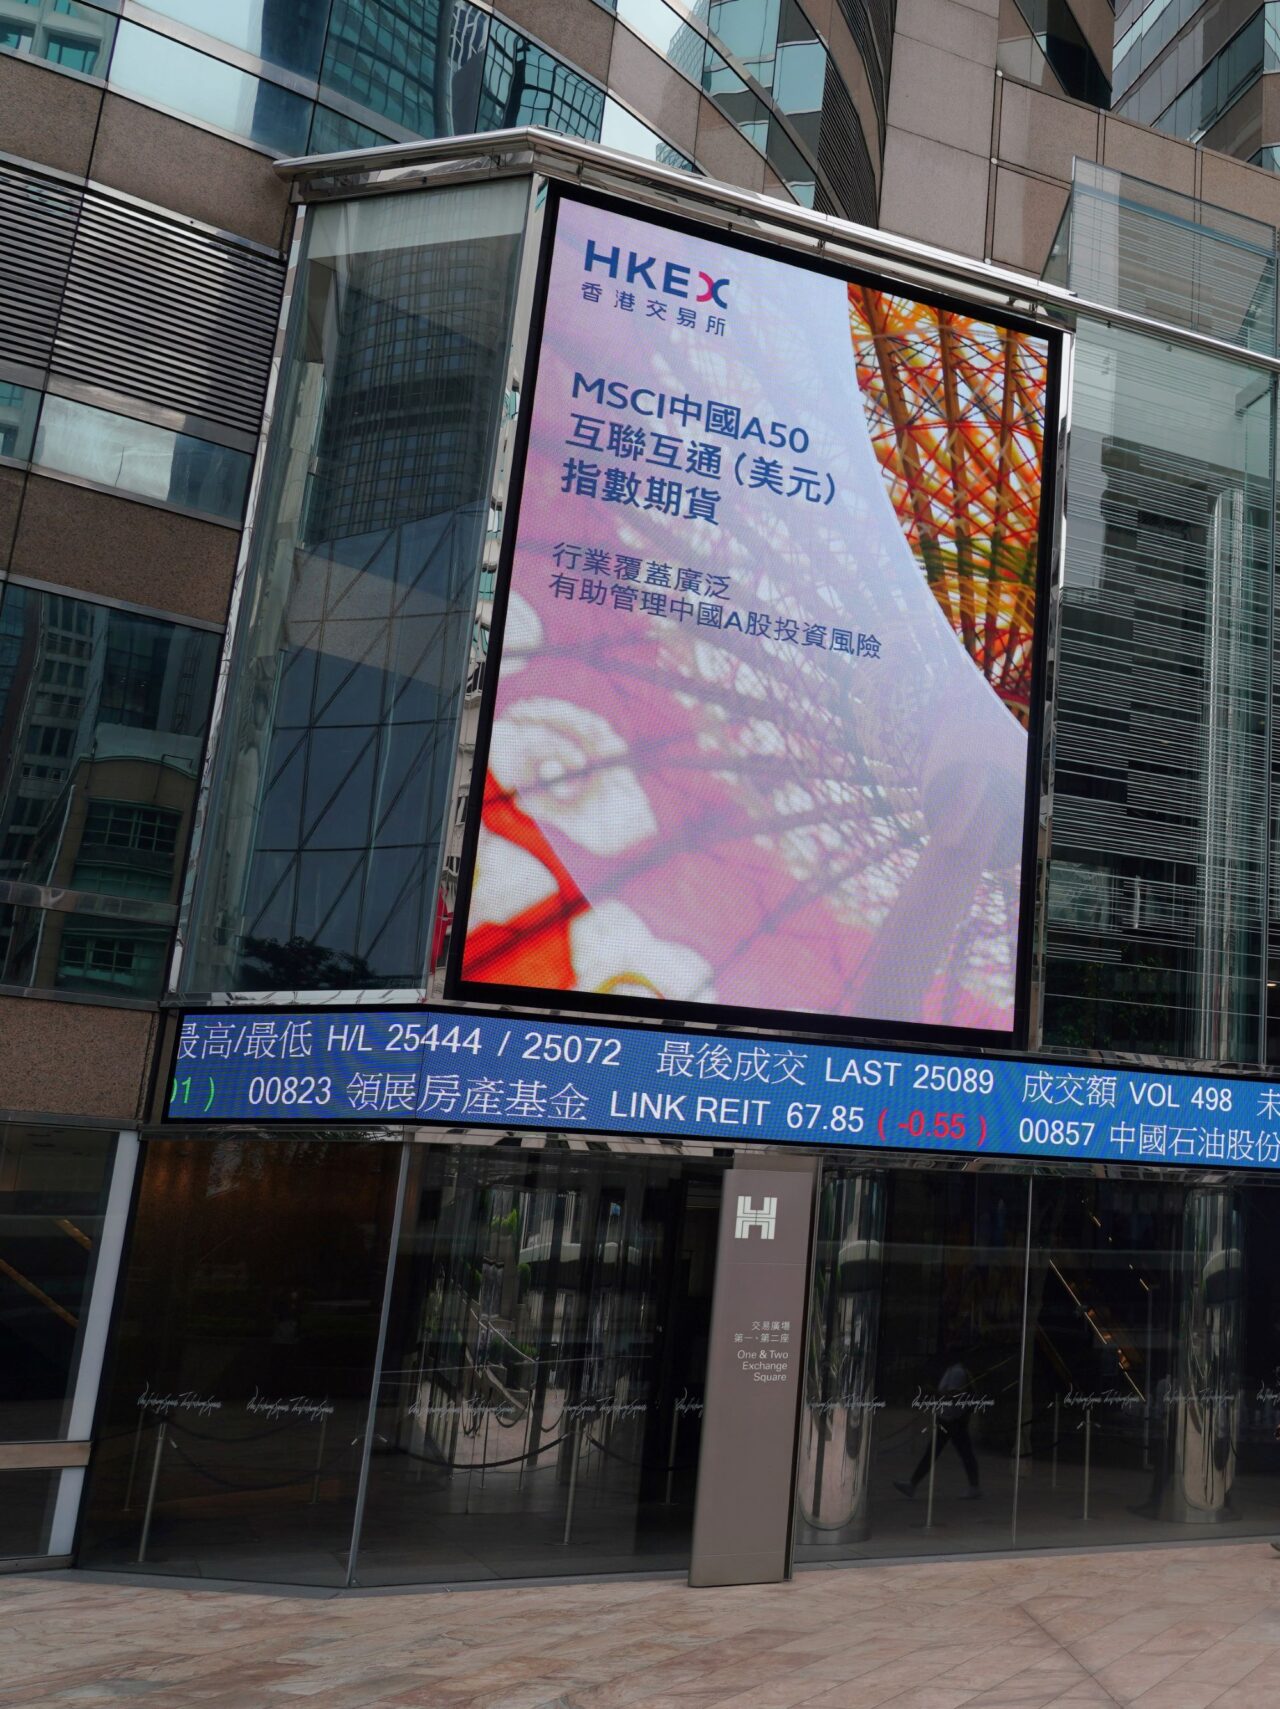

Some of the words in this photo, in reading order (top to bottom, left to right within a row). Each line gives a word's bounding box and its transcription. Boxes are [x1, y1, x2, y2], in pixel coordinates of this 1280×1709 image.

[584, 239, 731, 309] HKEX
[581, 281, 727, 337] 香港交易所
[571, 371, 810, 454] MSCI中國A50
[561, 457, 722, 526] 指數期貨
[552, 542, 732, 600] 行業覆蓋廣泛
[548, 573, 883, 659] 有助管理中國A股投資風險
[328, 1024, 373, 1052] H/L
[385, 1024, 482, 1055] 25444
[522, 1032, 621, 1066] 25072
[657, 1039, 807, 1087] 最後成交
[825, 1057, 902, 1088] LAST
[914, 1064, 994, 1095] 25089
[1022, 1070, 1117, 1109] 成交額
[1129, 1082, 1180, 1108] VOL
[1191, 1086, 1232, 1112] 498
[248, 1077, 331, 1105] 00823
[346, 1073, 590, 1121] 領展房產基金
[610, 1090, 687, 1122] LINK
[696, 1097, 771, 1126] REIT
[786, 1102, 865, 1133] 67.85
[1019, 1118, 1095, 1146] 00857
[737, 1349, 757, 1359] One
[759, 1349, 767, 1359] &
[769, 1350, 789, 1359] Two
[742, 1361, 788, 1372] Exchange
[753, 1372, 787, 1383] Square
